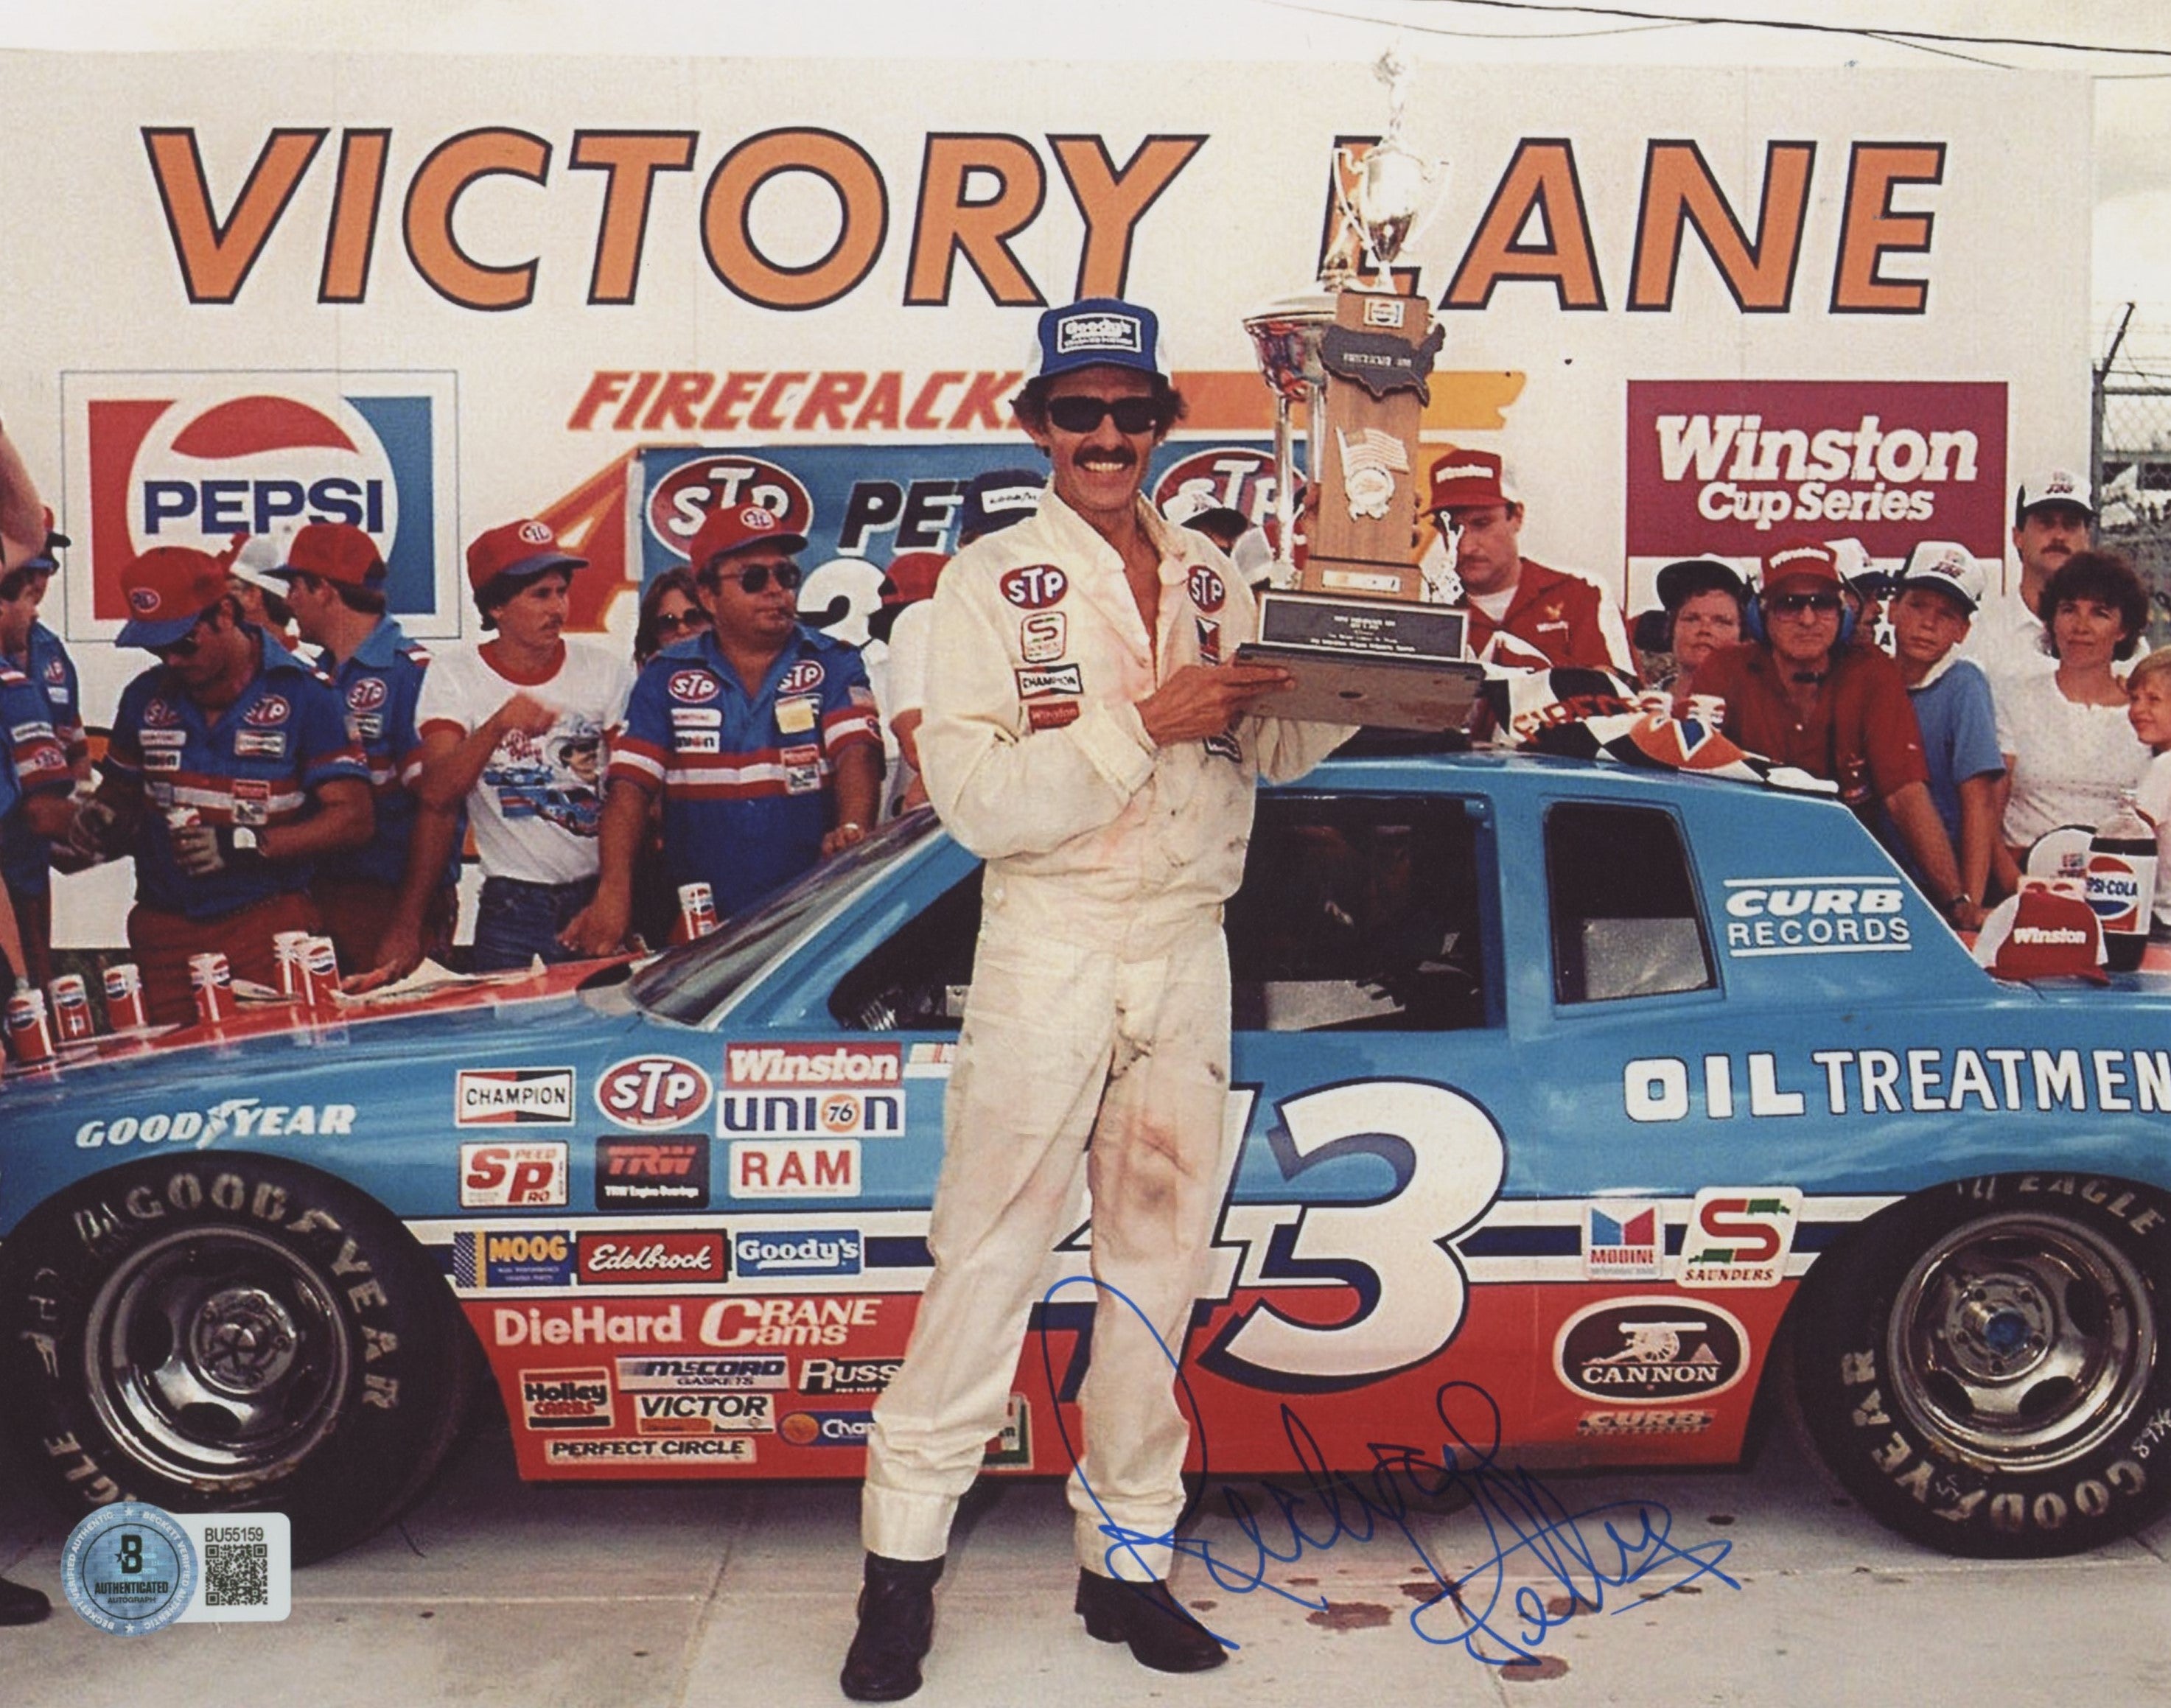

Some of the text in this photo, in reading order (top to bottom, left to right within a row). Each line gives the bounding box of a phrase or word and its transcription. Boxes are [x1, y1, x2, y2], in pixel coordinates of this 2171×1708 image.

[140, 125, 1948, 314] VICTORY LANE
[566, 370, 1024, 431] FIRECRACK
[1655, 413, 1979, 483] Winston
[143, 477, 383, 534] PEPSI
[836, 480, 971, 556] PE
[1698, 481, 1935, 531] Cup Series
[1007, 567, 1064, 604] STP
[1189, 569, 1224, 606] STP
[674, 673, 716, 697] STP
[1725, 889, 1904, 917] CURB
[1727, 917, 1910, 947] RECORDS
[2013, 926, 2087, 945] Winston
[729, 1047, 898, 1082] Winston
[466, 1086, 567, 1106] CHAMPION
[609, 1062, 696, 1115] STP
[1623, 1048, 2171, 1123] OIL TREATMEN
[75, 1098, 357, 1149] GOODYEAR
[828, 1102, 853, 1123] 76
[606, 1145, 697, 1175] TRW
[741, 1149, 852, 1187] RAM
[489, 1235, 568, 1263] MOOG
[588, 1243, 712, 1271] Edelbrock
[737, 1238, 860, 1269] Goody's
[1685, 1268, 1775, 1281] SAUNDERS
[494, 1305, 682, 1346] DieHard
[798, 1358, 901, 1390] RUSS
[1581, 1365, 1719, 1385] CANNON
[524, 1382, 607, 1406] Holley
[534, 1401, 596, 1415] CARBS
[641, 1396, 768, 1417] VICTOR
[822, 1418, 875, 1438] Cha
[552, 1440, 746, 1456] PERFECT CIRCLE
